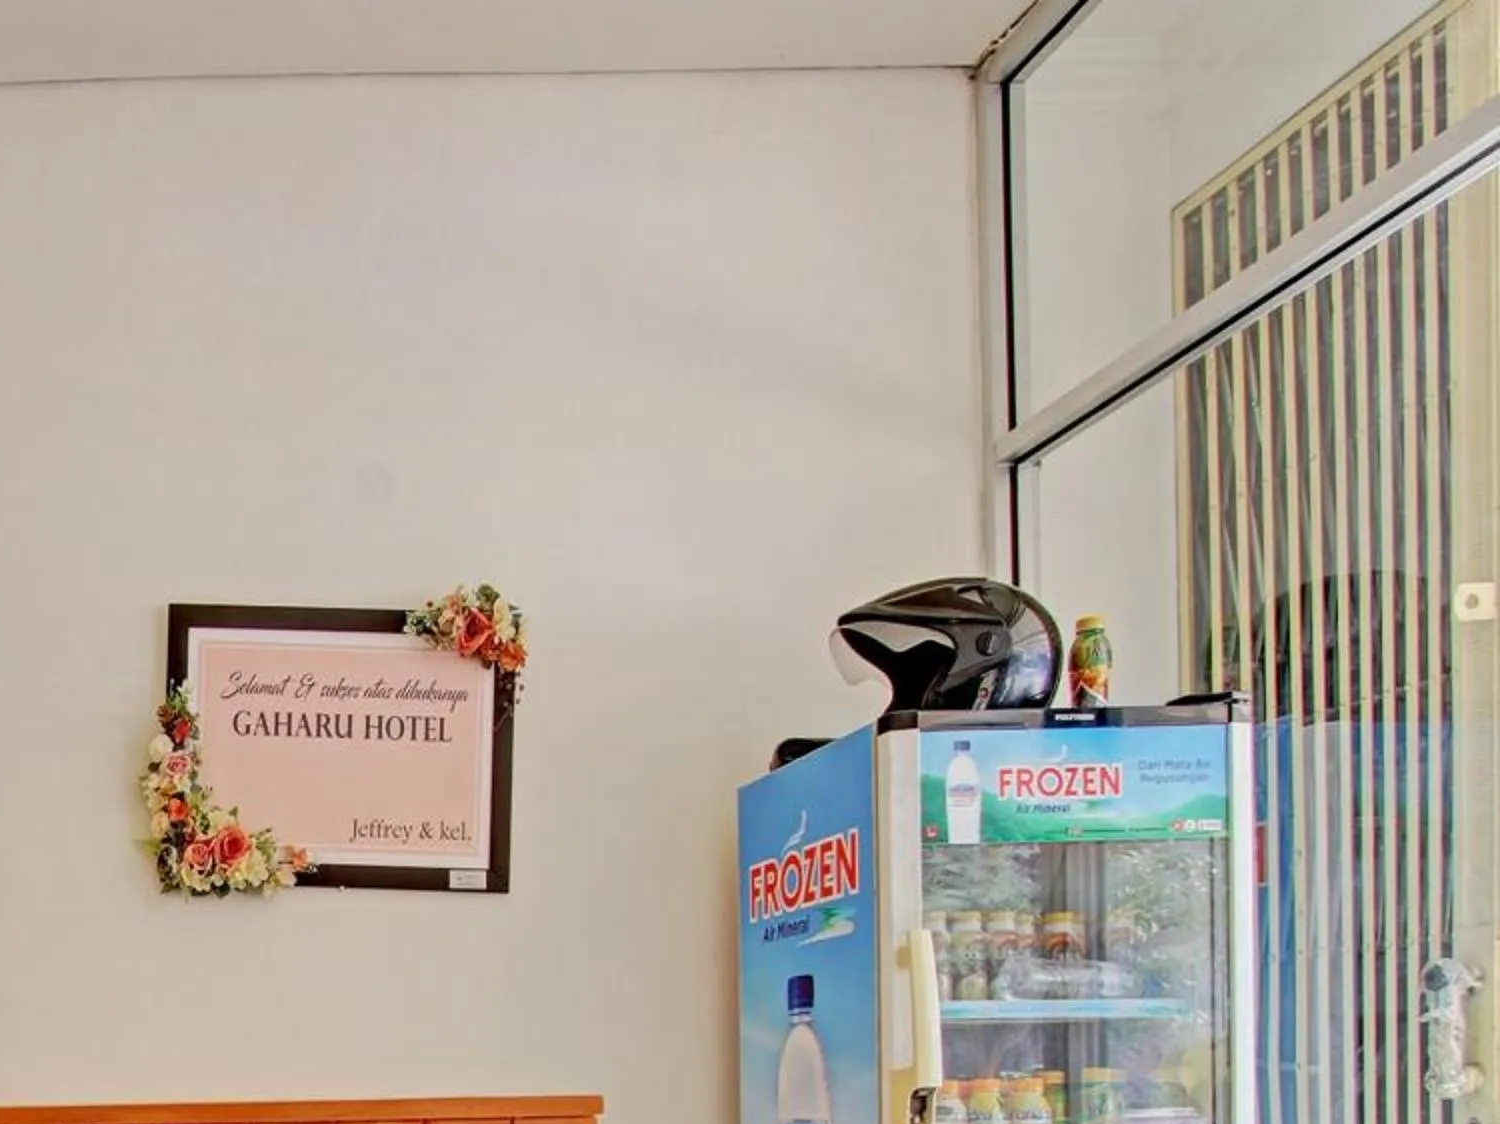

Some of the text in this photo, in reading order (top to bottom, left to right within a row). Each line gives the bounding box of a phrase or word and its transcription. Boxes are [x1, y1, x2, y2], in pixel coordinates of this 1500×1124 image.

[220, 671, 291, 700] Selamat
[319, 677, 362, 700] sukses
[363, 678, 394, 701] atas
[395, 679, 469, 713] dibukanya
[232, 709, 453, 743] GAHARU HOTEL
[997, 764, 1122, 799] FROZEN
[349, 818, 472, 843] Jeffrey & kel.
[749, 829, 859, 923] FROZEN
